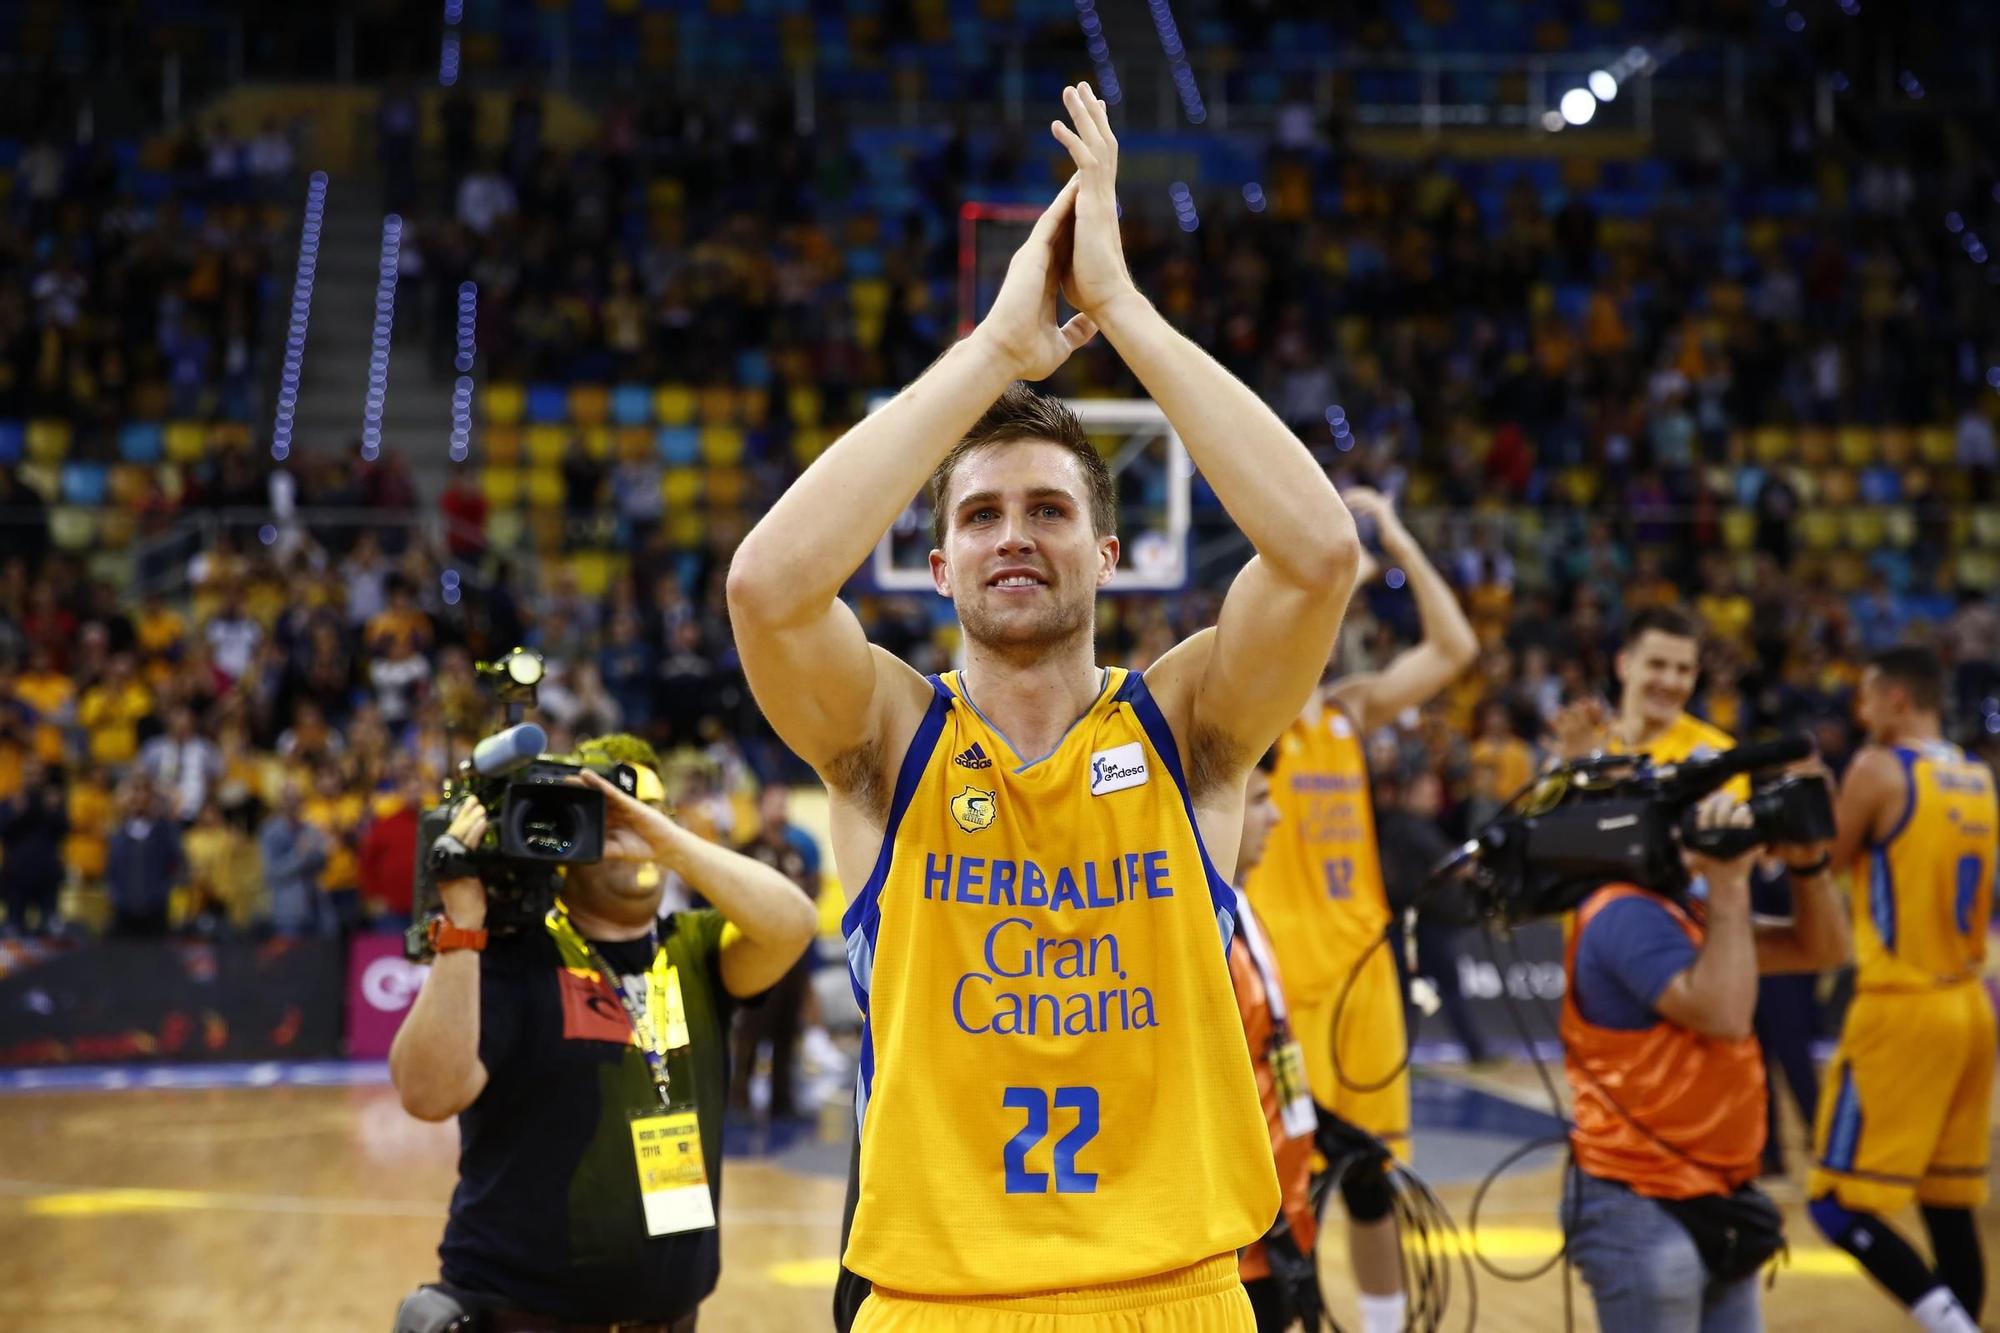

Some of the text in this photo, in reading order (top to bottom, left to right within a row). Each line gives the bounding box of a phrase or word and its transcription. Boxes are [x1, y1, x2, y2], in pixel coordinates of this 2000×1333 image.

[954, 757, 993, 769] adidas
[1102, 763, 1118, 773] liga
[1104, 765, 1145, 781] endesa
[924, 850, 1174, 912] HERBALIFE
[984, 917, 1121, 979] Gran
[952, 970, 1159, 1037] Canaria
[1002, 1086, 1100, 1194] 22
